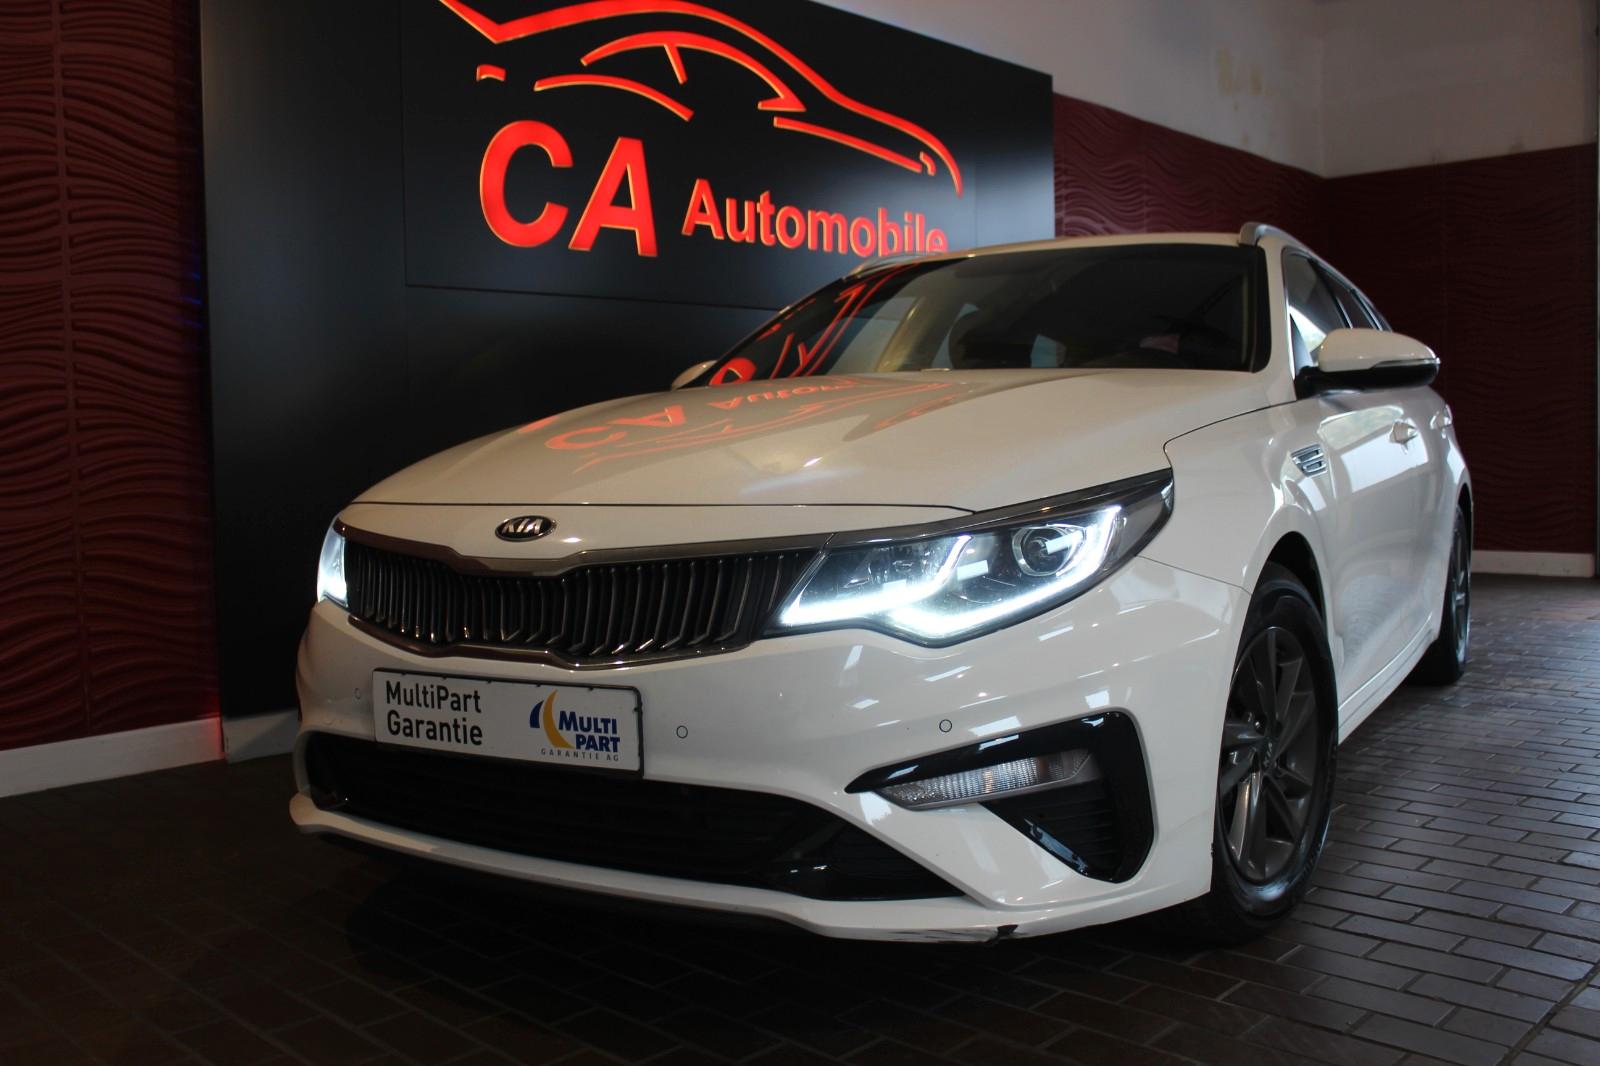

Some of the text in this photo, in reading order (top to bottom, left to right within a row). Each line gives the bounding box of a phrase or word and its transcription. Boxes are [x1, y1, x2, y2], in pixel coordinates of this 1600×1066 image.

[480, 119, 948, 257] CA Automobile
[501, 518, 543, 534] KIA
[386, 680, 482, 713] MultiPart
[387, 709, 482, 746] Garantie
[558, 711, 617, 734] MULTI
[576, 733, 620, 753] PART
[541, 748, 619, 762] GARANTIE AG
